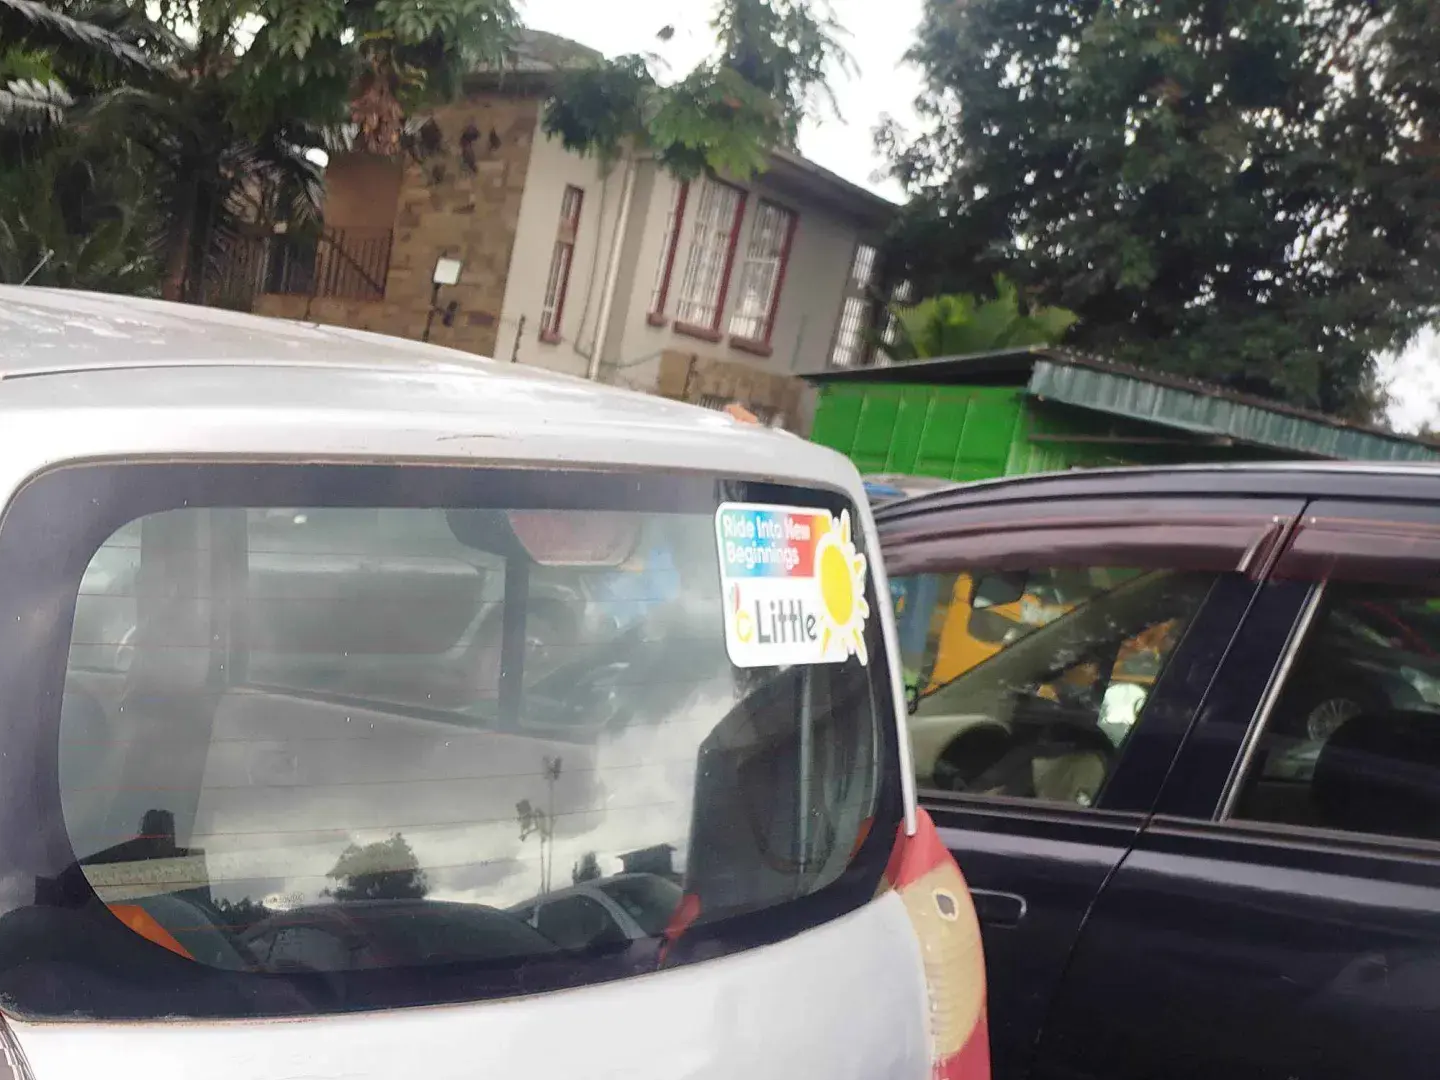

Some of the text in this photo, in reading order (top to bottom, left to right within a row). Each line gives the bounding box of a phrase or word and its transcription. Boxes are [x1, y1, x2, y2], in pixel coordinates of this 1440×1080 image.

[722, 514, 755, 538] Ride
[726, 540, 800, 570] Beginnings
[755, 599, 817, 643] Little
